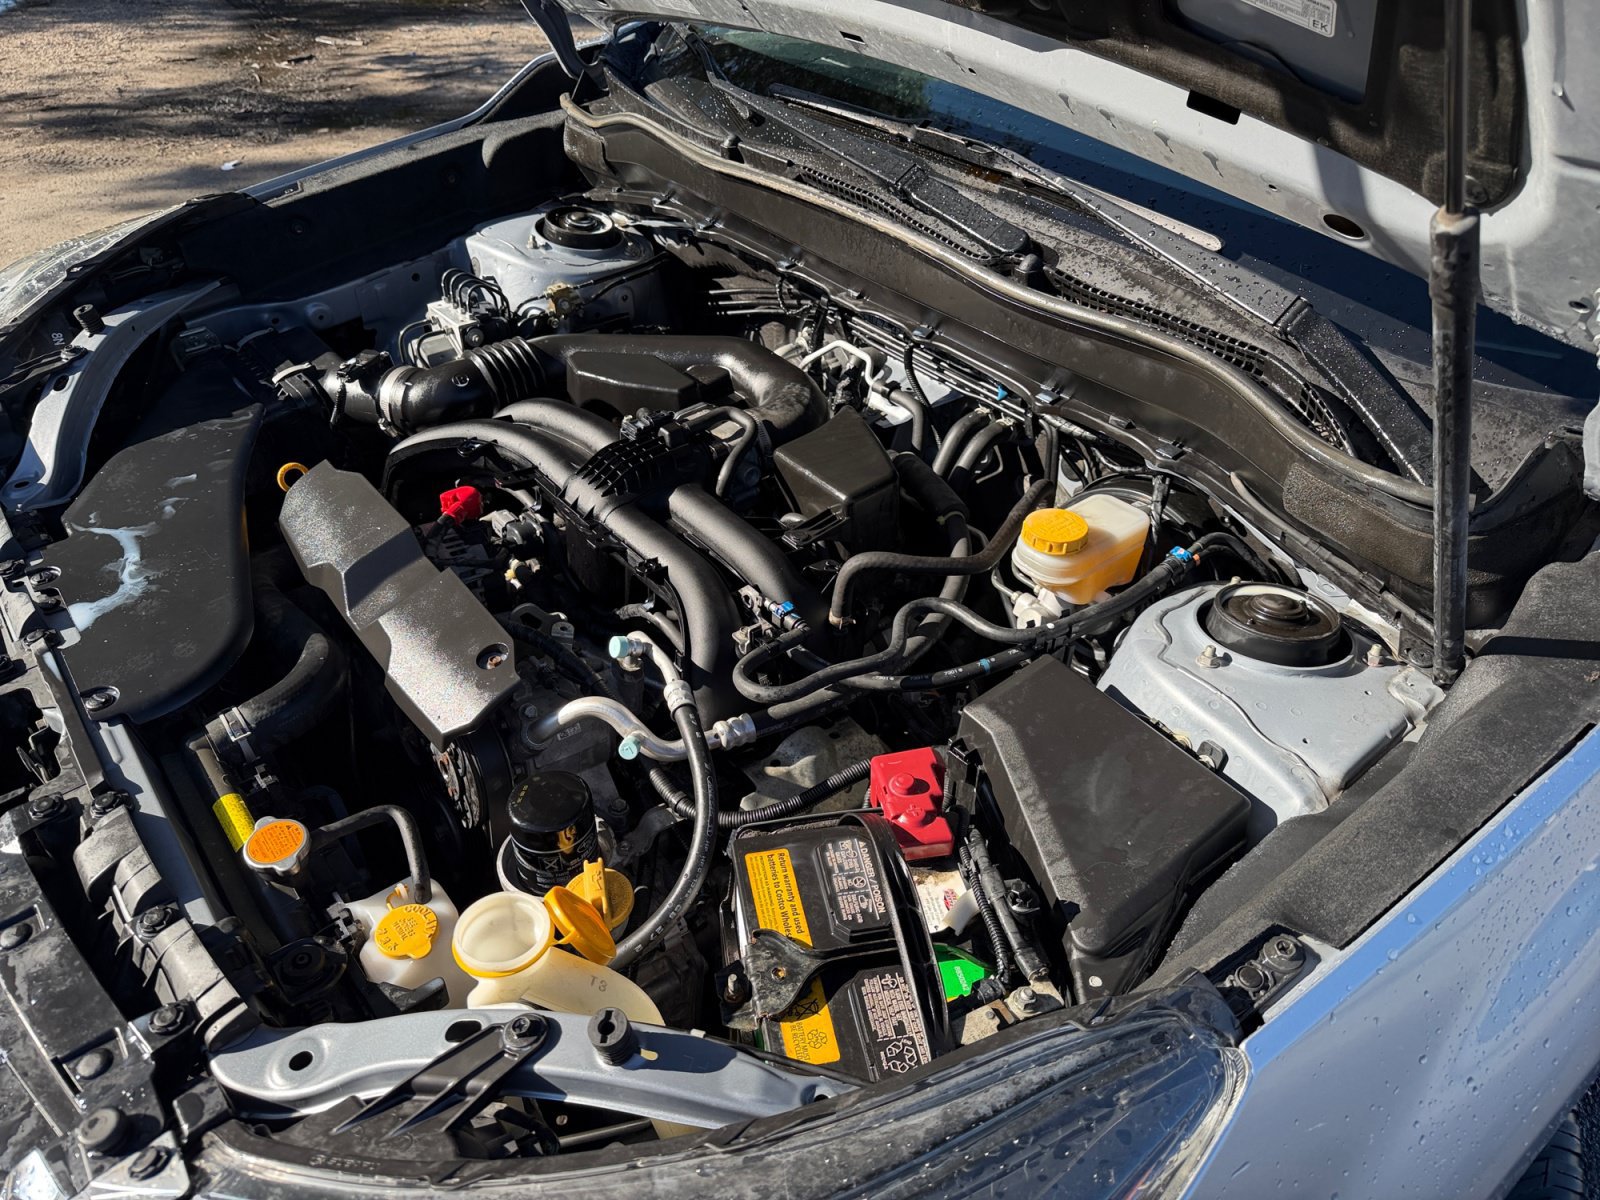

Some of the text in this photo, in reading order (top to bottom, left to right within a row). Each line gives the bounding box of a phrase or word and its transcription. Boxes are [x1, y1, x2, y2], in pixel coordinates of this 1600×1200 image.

[1313, 19, 1328, 33] EK
[766, 853, 793, 939] batteries to Costco Wholes
[777, 852, 805, 935] Return warranty and used
[860, 848, 876, 878] DANGER
[871, 884, 887, 914] POISON
